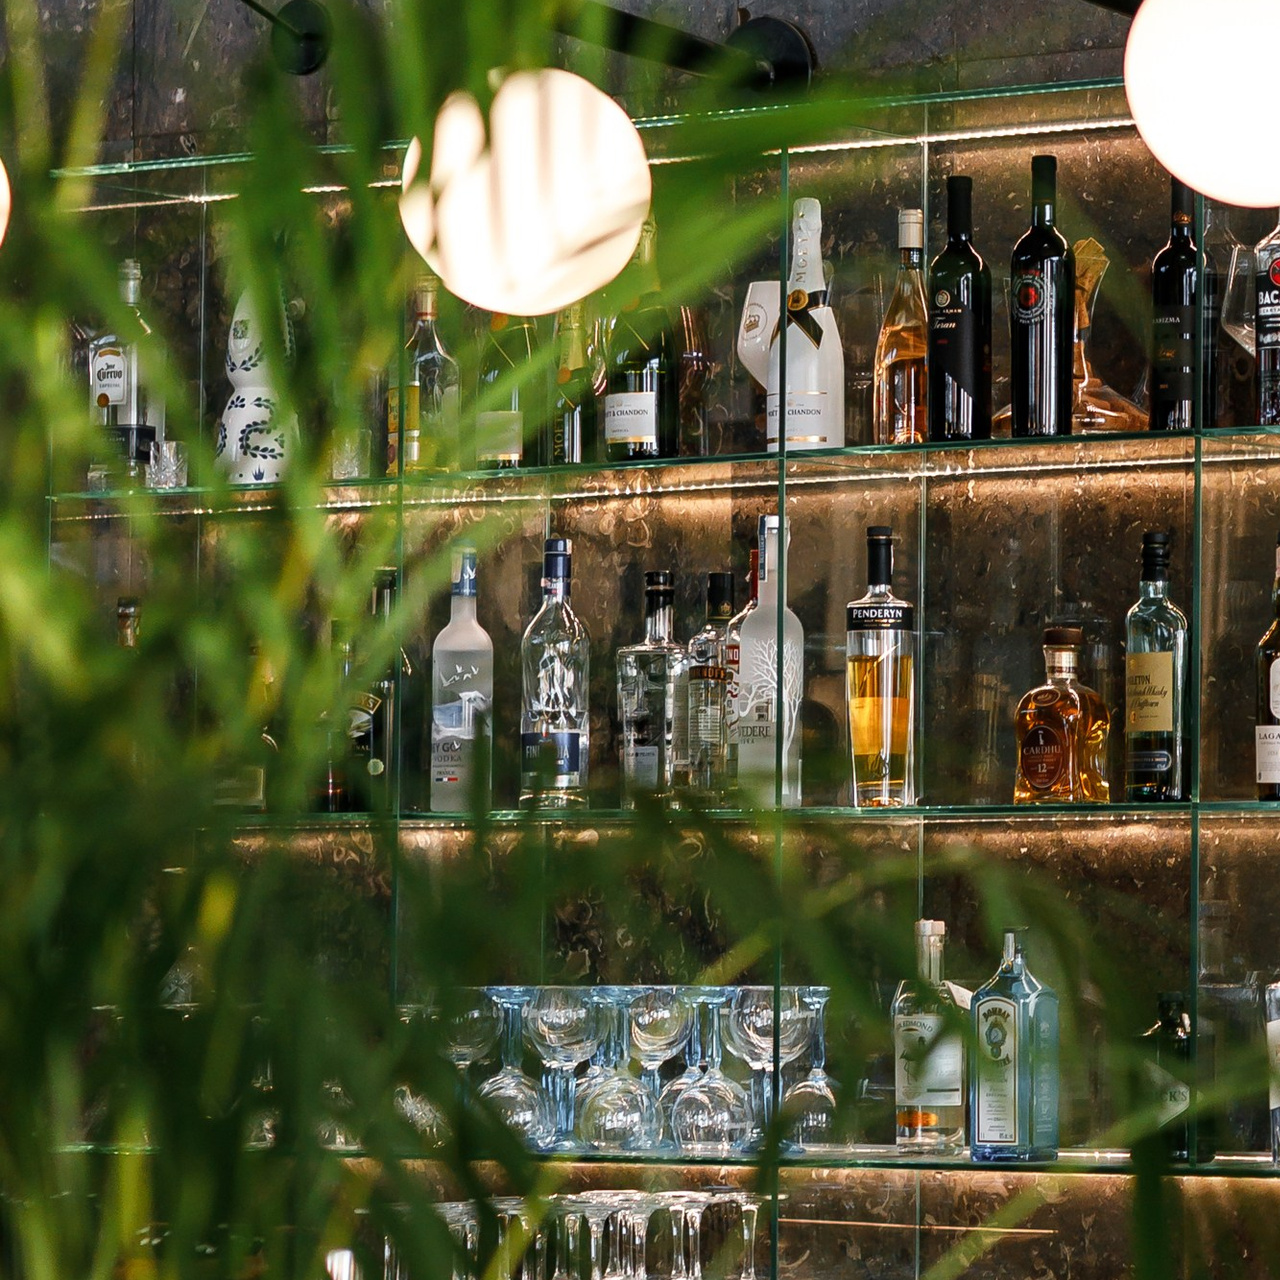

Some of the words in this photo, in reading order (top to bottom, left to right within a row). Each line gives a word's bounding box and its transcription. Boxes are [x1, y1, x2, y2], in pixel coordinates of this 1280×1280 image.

[97, 368, 123, 381] Cuervo
[852, 608, 903, 619] PENDERYN
[1023, 745, 1061, 755] CARDHU
[1037, 763, 1047, 773] 12
[981, 1006, 1011, 1023] BOMBAY
